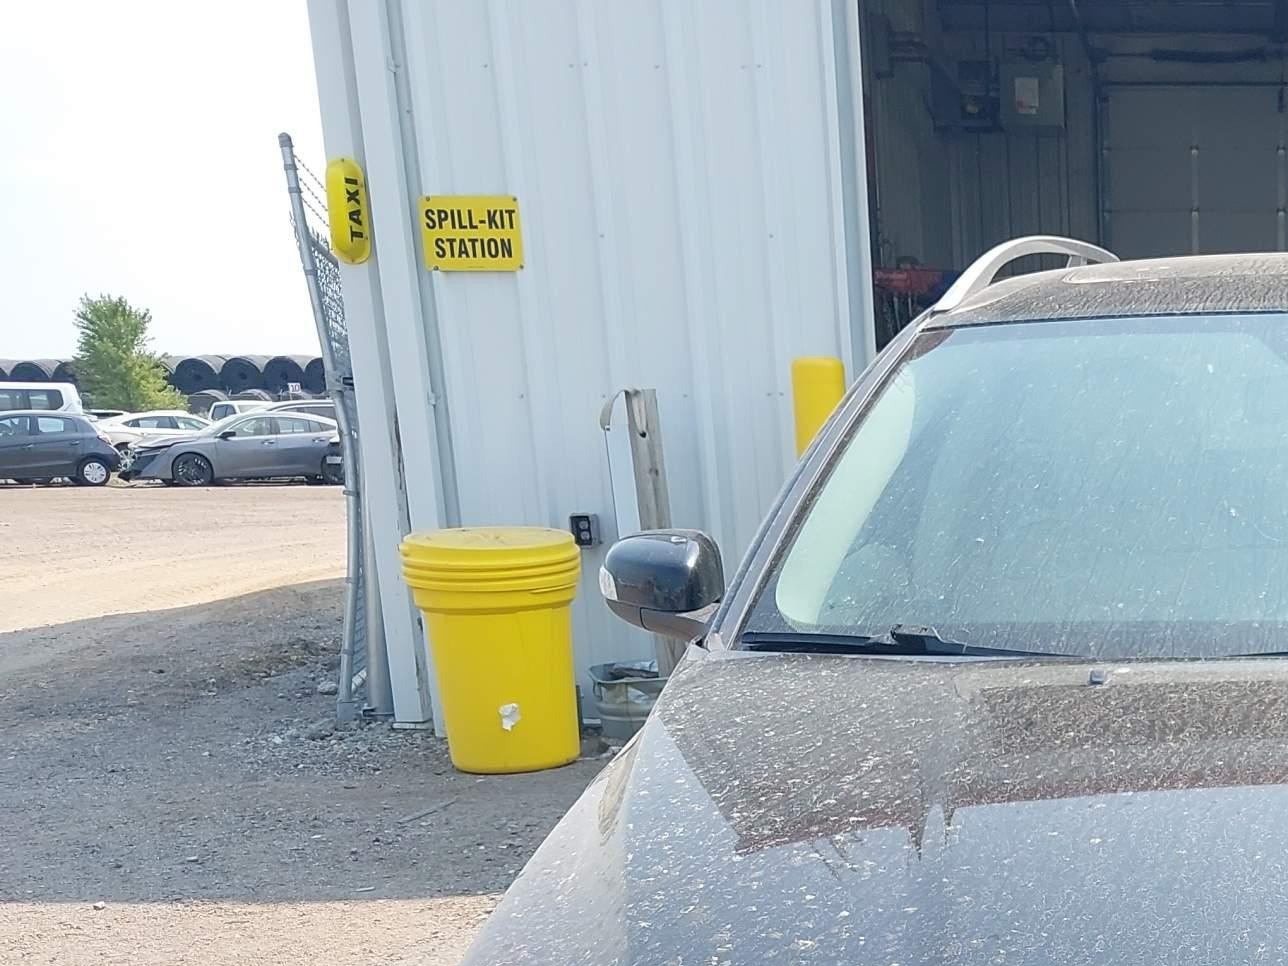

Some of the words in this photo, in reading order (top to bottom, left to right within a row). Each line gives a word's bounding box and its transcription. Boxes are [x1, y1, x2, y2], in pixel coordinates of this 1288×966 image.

[344, 176, 364, 243] TAXI
[424, 208, 516, 230] SPILL-KIT
[434, 237, 513, 259] STATION
